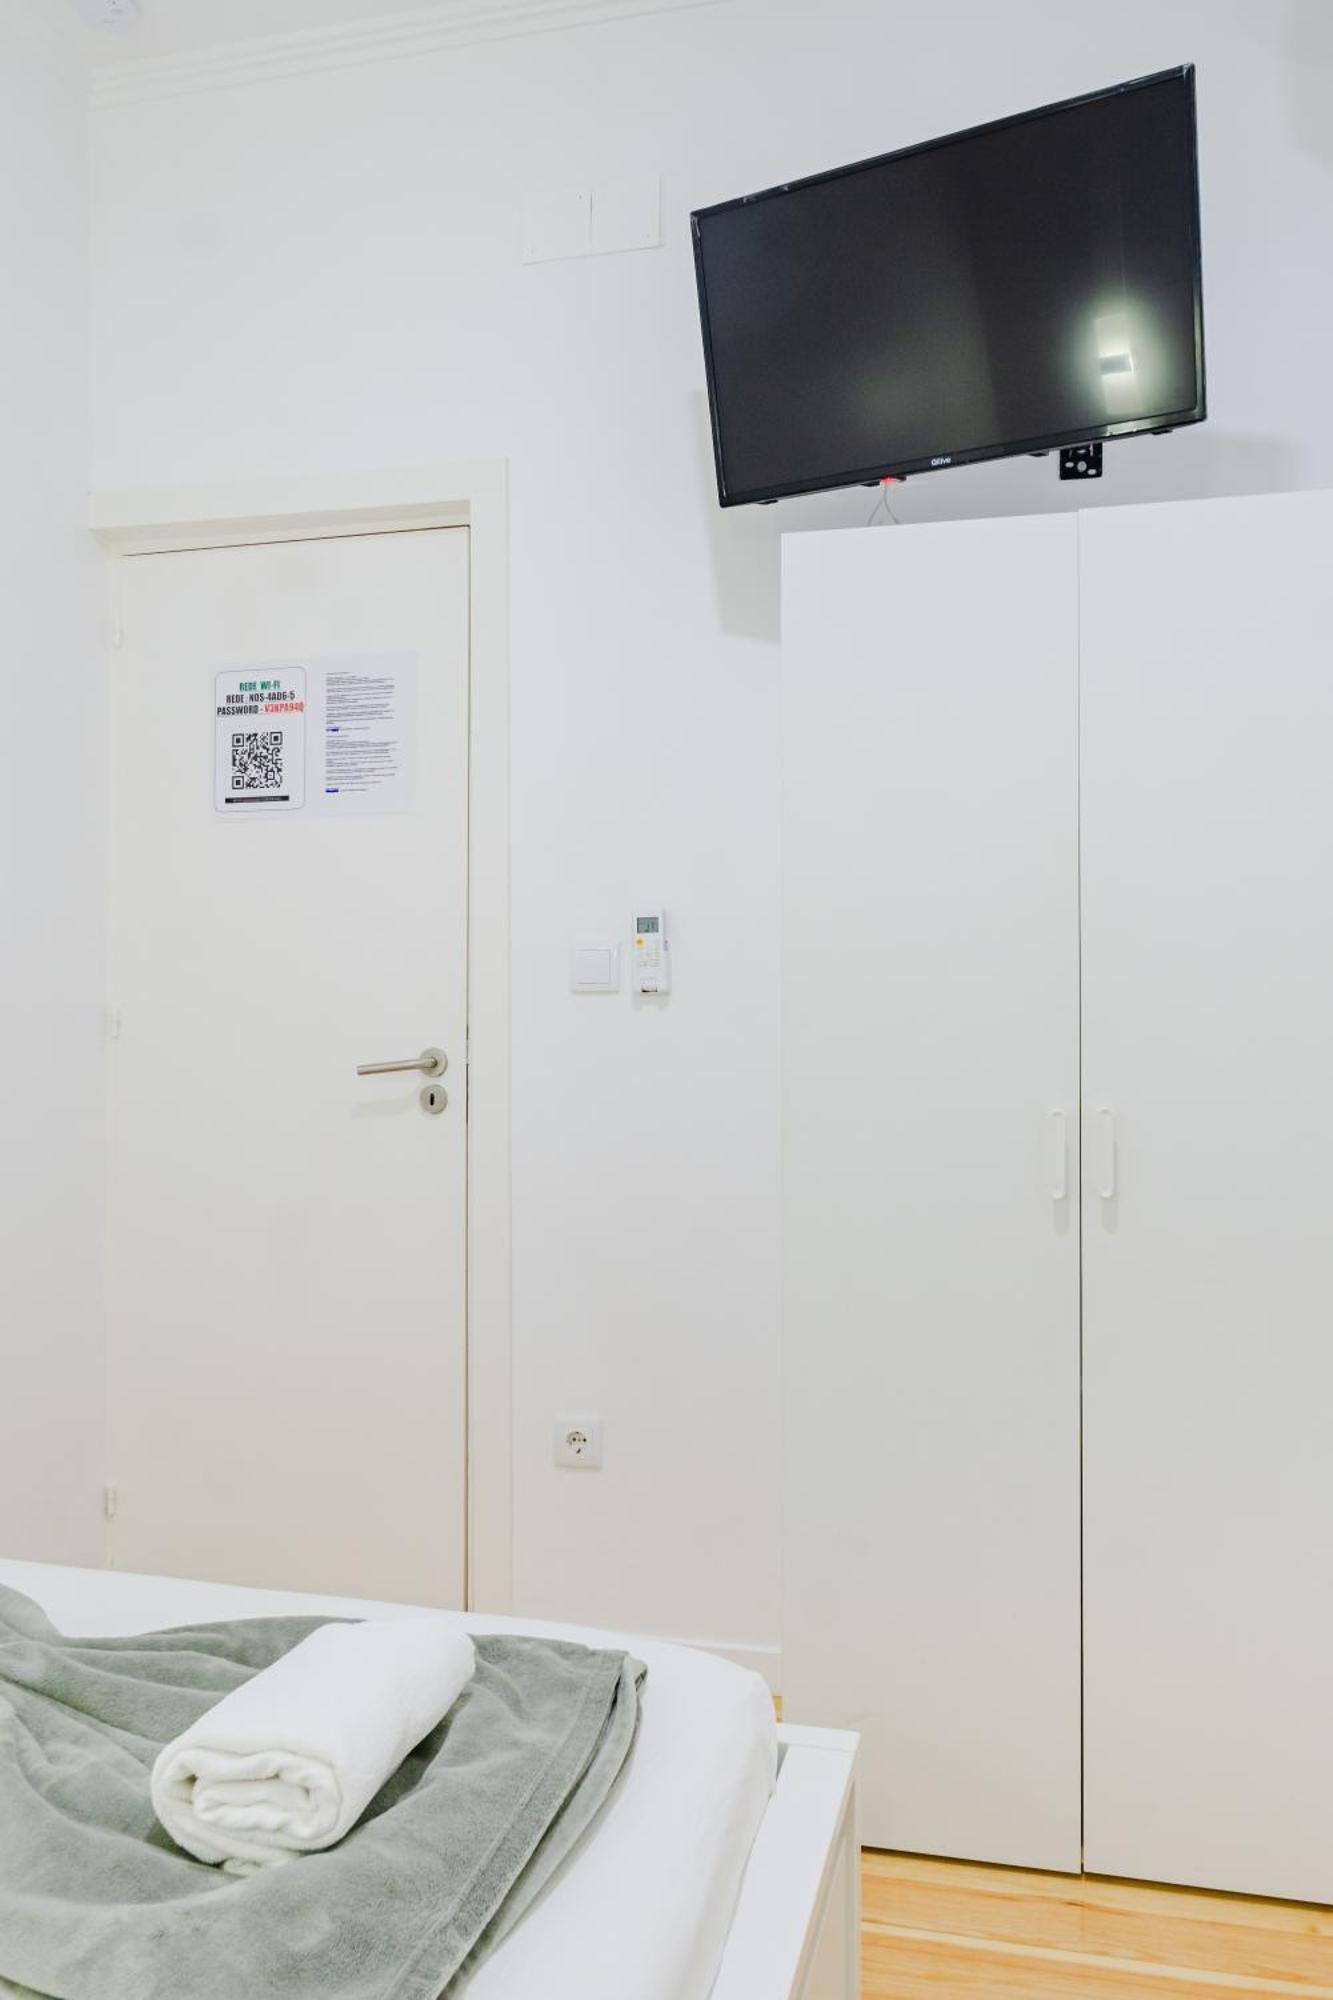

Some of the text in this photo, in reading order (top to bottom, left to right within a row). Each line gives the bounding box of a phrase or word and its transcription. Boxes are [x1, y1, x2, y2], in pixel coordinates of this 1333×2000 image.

[239, 680, 281, 691] REDE WI-FI
[225, 694, 244, 704] REDE
[216, 705, 259, 716] PASSWORD
